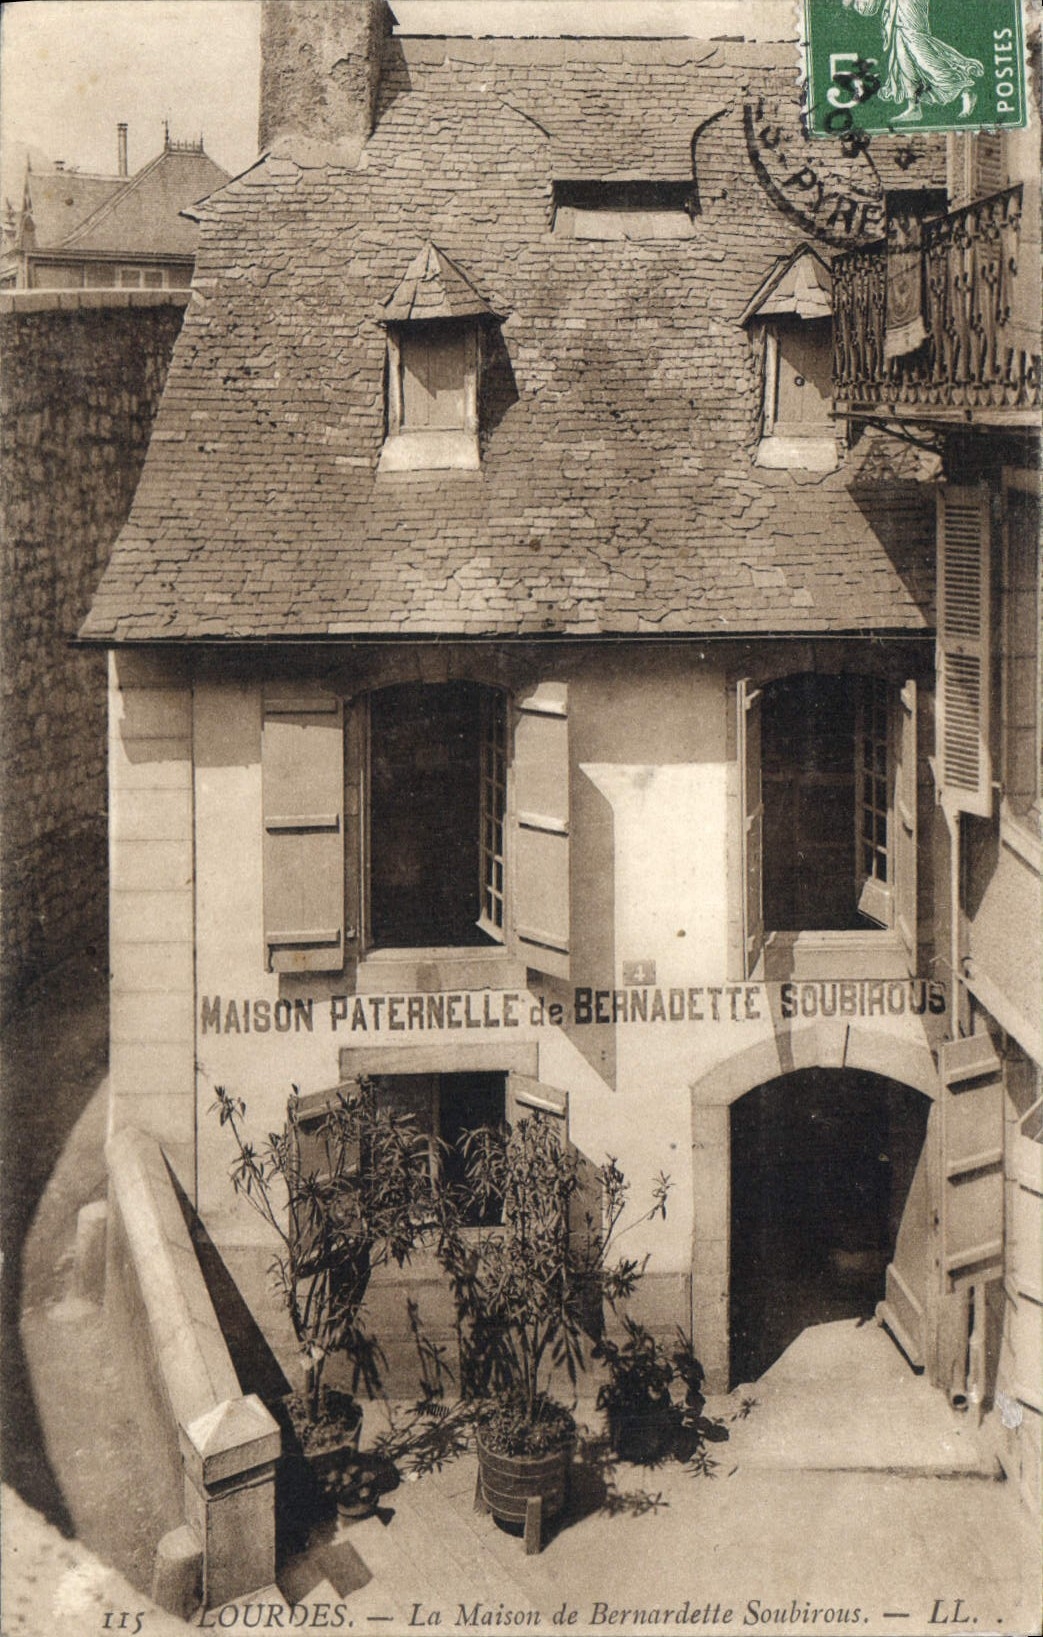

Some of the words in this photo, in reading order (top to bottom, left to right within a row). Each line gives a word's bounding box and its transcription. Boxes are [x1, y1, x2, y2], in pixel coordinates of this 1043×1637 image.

[993, 27, 1015, 113] POSTES
[201, 995, 313, 1035] MAISON
[331, 994, 519, 1032] PATERNELLE
[529, 996, 563, 1026] de
[575, 987, 761, 1025] BERNADETTE
[781, 981, 946, 1018] SOUBIROUS
